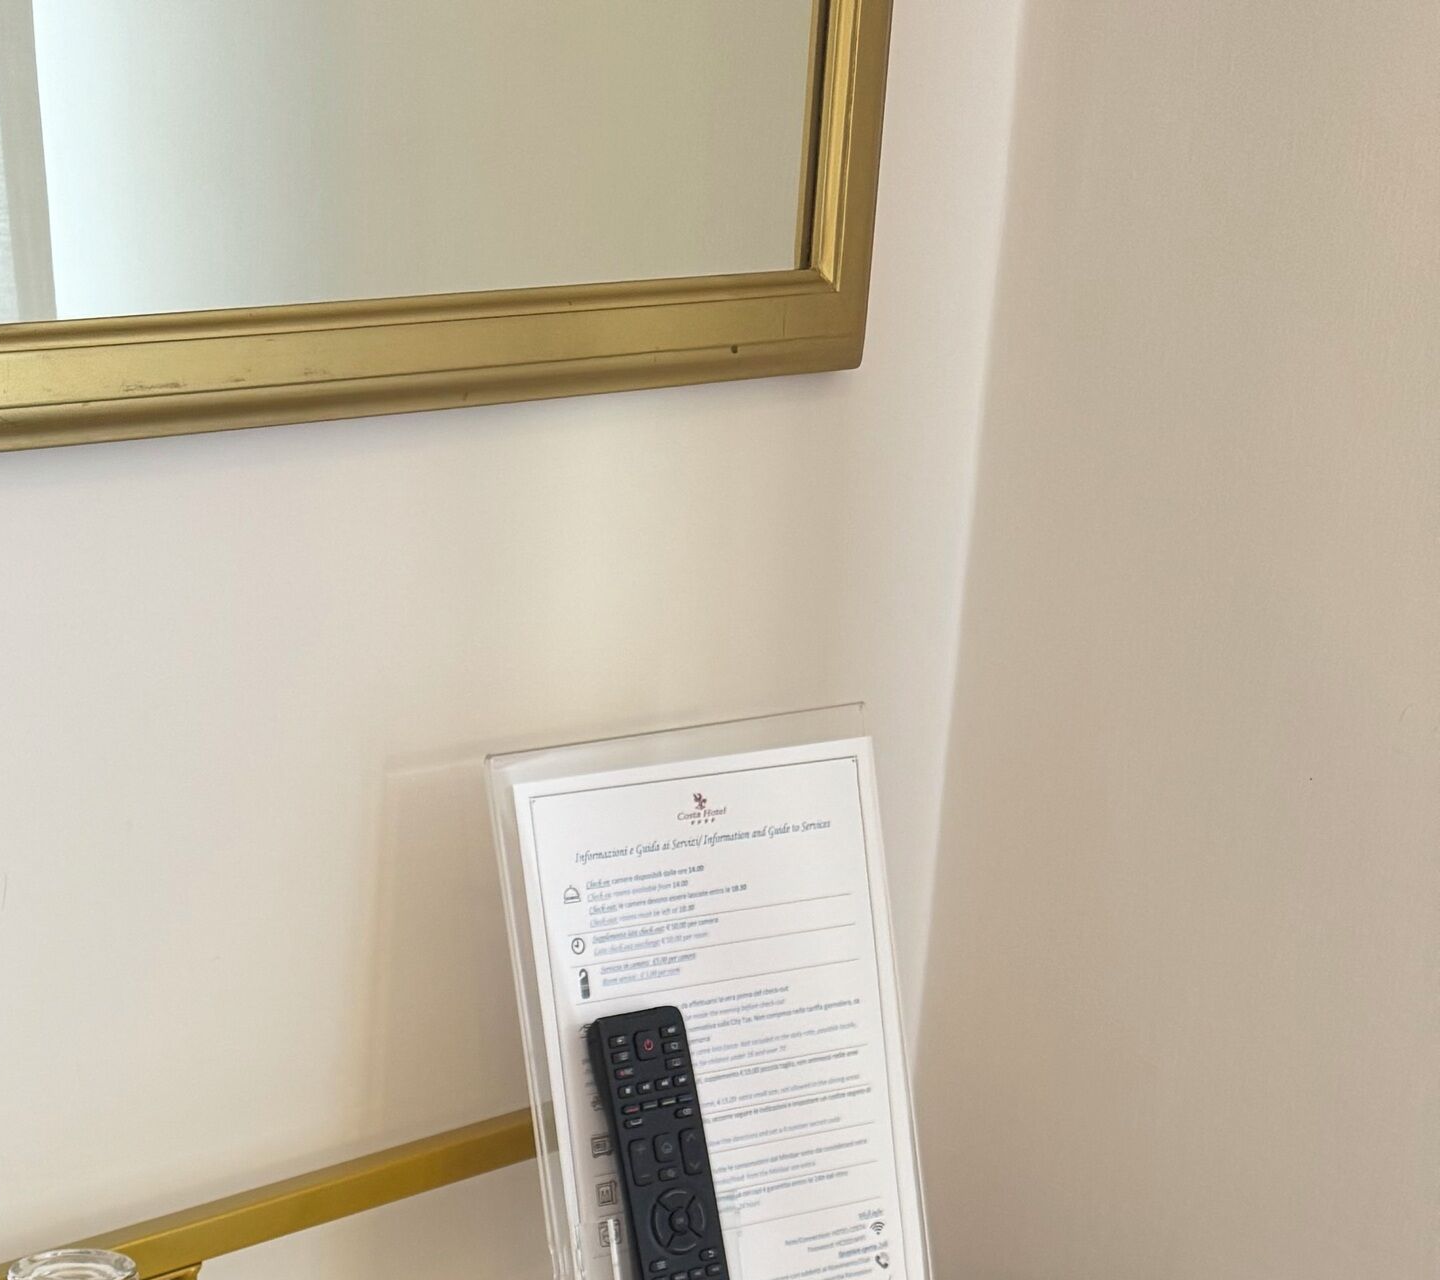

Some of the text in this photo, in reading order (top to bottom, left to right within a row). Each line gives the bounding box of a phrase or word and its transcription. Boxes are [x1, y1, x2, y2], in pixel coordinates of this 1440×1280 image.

[676, 806, 727, 821] Costa Hotel
[574, 844, 628, 865] Informazioni
[634, 840, 660, 857] Guida
[702, 827, 750, 847] Information
[750, 825, 768, 838] and
[767, 822, 790, 838] Guide
[791, 822, 799, 832] to
[800, 817, 831, 832] Services
